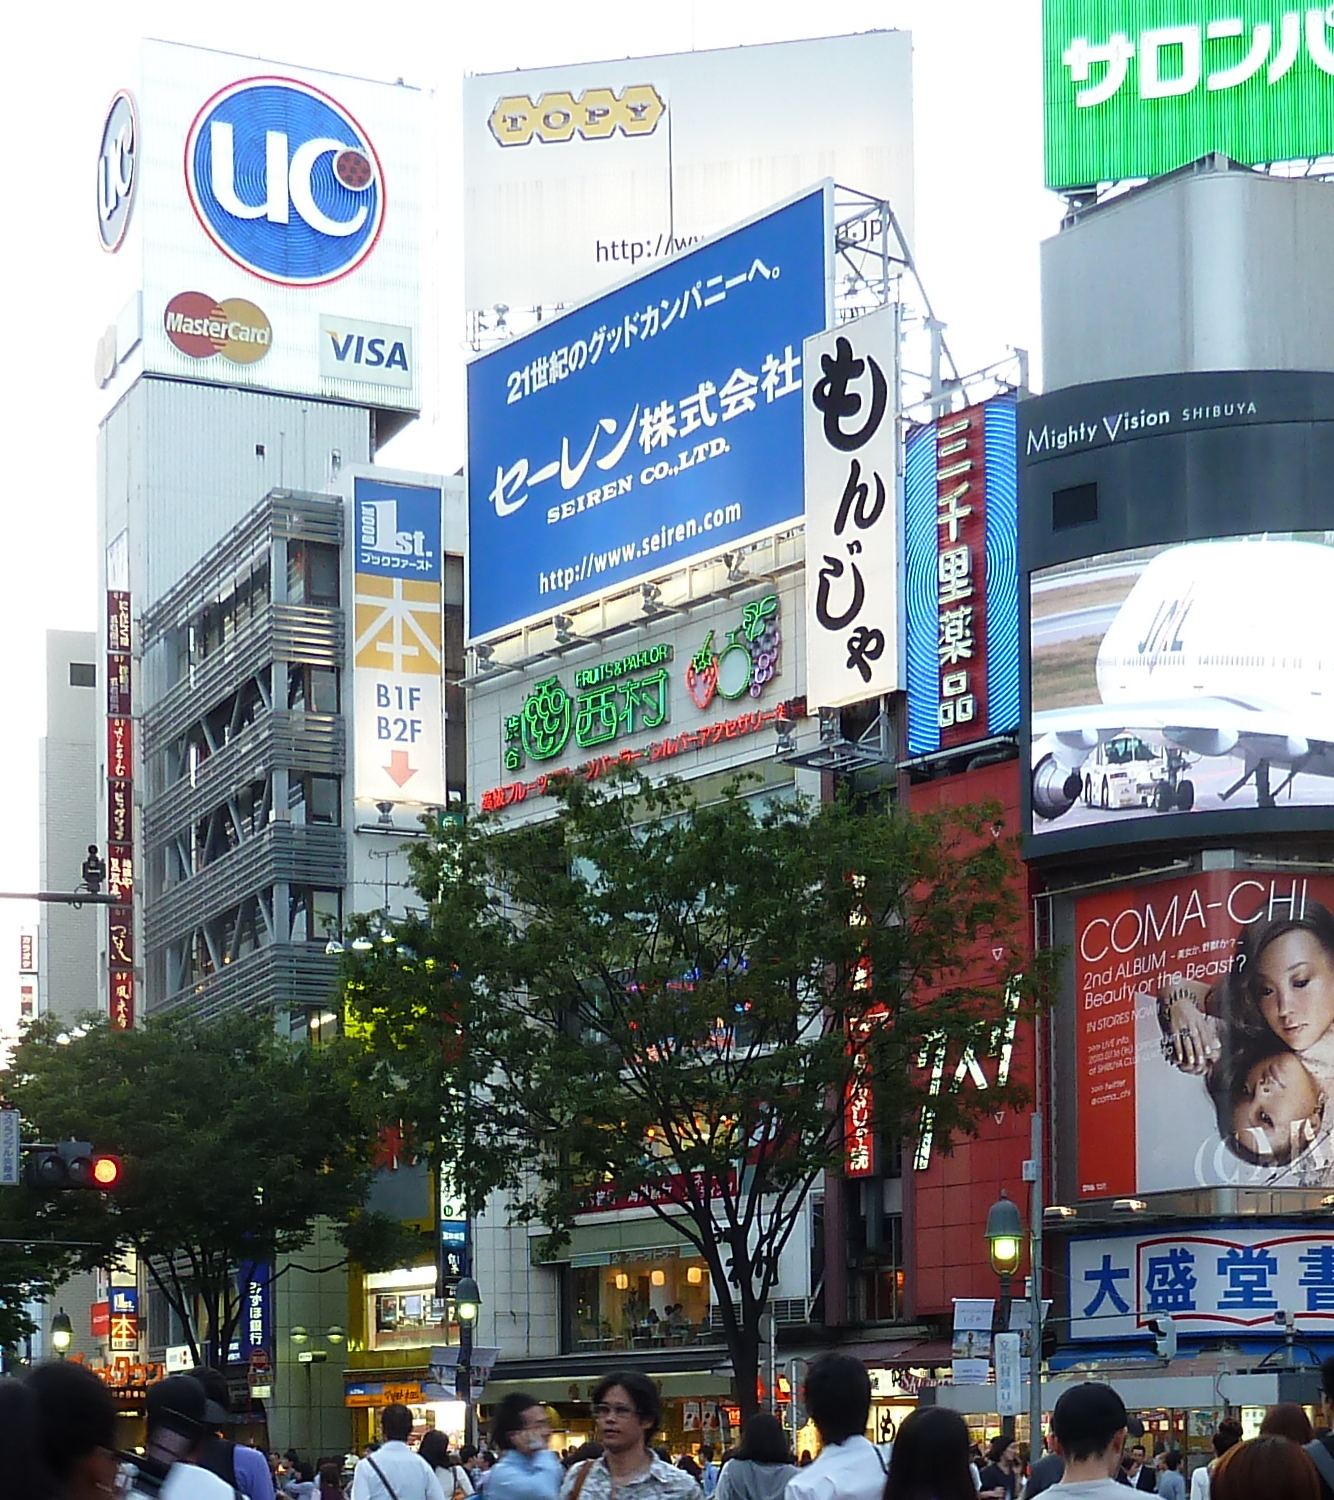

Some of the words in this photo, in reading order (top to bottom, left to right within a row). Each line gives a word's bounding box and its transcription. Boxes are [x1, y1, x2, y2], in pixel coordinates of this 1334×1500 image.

[502, 102, 654, 132] TOPY
[166, 311, 270, 346] MasterCard
[325, 330, 409, 371] VISA
[507, 258, 780, 405] 21世紀のグッドカンパニーへ。
[488, 344, 803, 517] セーレン株式会社
[1027, 423, 1098, 455] Mighty
[1103, 408, 1170, 441] Vision
[1182, 402, 1257, 422] SHIBUYA
[546, 474, 633, 525] SEIREN
[640, 436, 731, 486] CO.,LTD.
[812, 336, 888, 684] もんじゃ
[361, 552, 433, 571] ブックファースト
[539, 502, 741, 594] http://www.seiren.com
[936, 416, 973, 730] 三千里薬品
[354, 577, 441, 674] 本
[575, 644, 669, 688] FRUITS&PARLOR
[376, 684, 422, 711] B1F
[576, 669, 668, 748] 西村
[377, 716, 423, 743] B2F
[505, 716, 521, 770] 渋谷
[1080, 879, 1309, 963] COMA-CHI
[1083, 967, 1116, 991] 2nd
[1115, 950, 1167, 982] ALBUM
[1084, 982, 1137, 1010] Beauty
[1138, 979, 1154, 995] or
[1157, 971, 1182, 989] the
[1186, 954, 1247, 981] Beast?
[1086, 1021, 1097, 1034] IN
[1096, 1012, 1130, 1031] STORES
